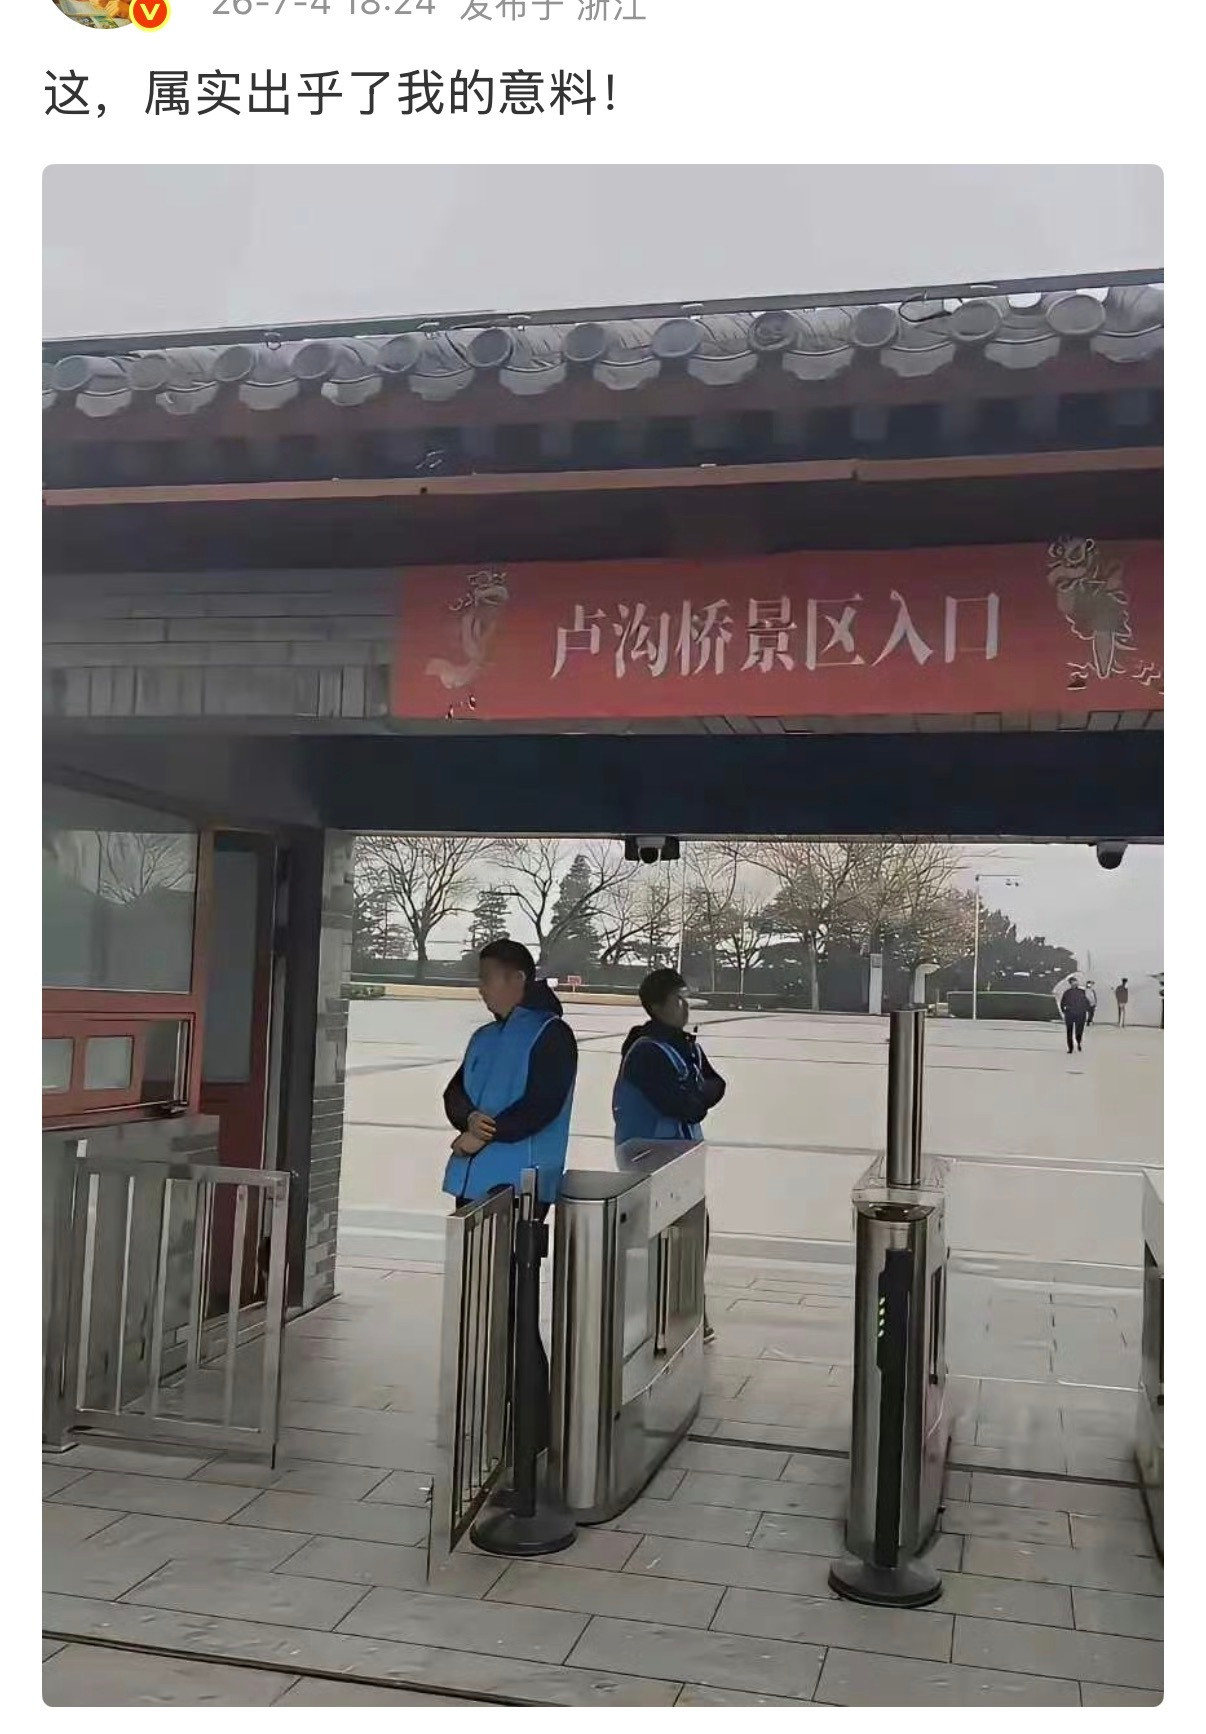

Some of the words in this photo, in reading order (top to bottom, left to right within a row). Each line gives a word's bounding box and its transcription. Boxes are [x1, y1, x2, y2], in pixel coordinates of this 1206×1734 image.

[550, 588, 1001, 679] 卢沟桥景区入口
